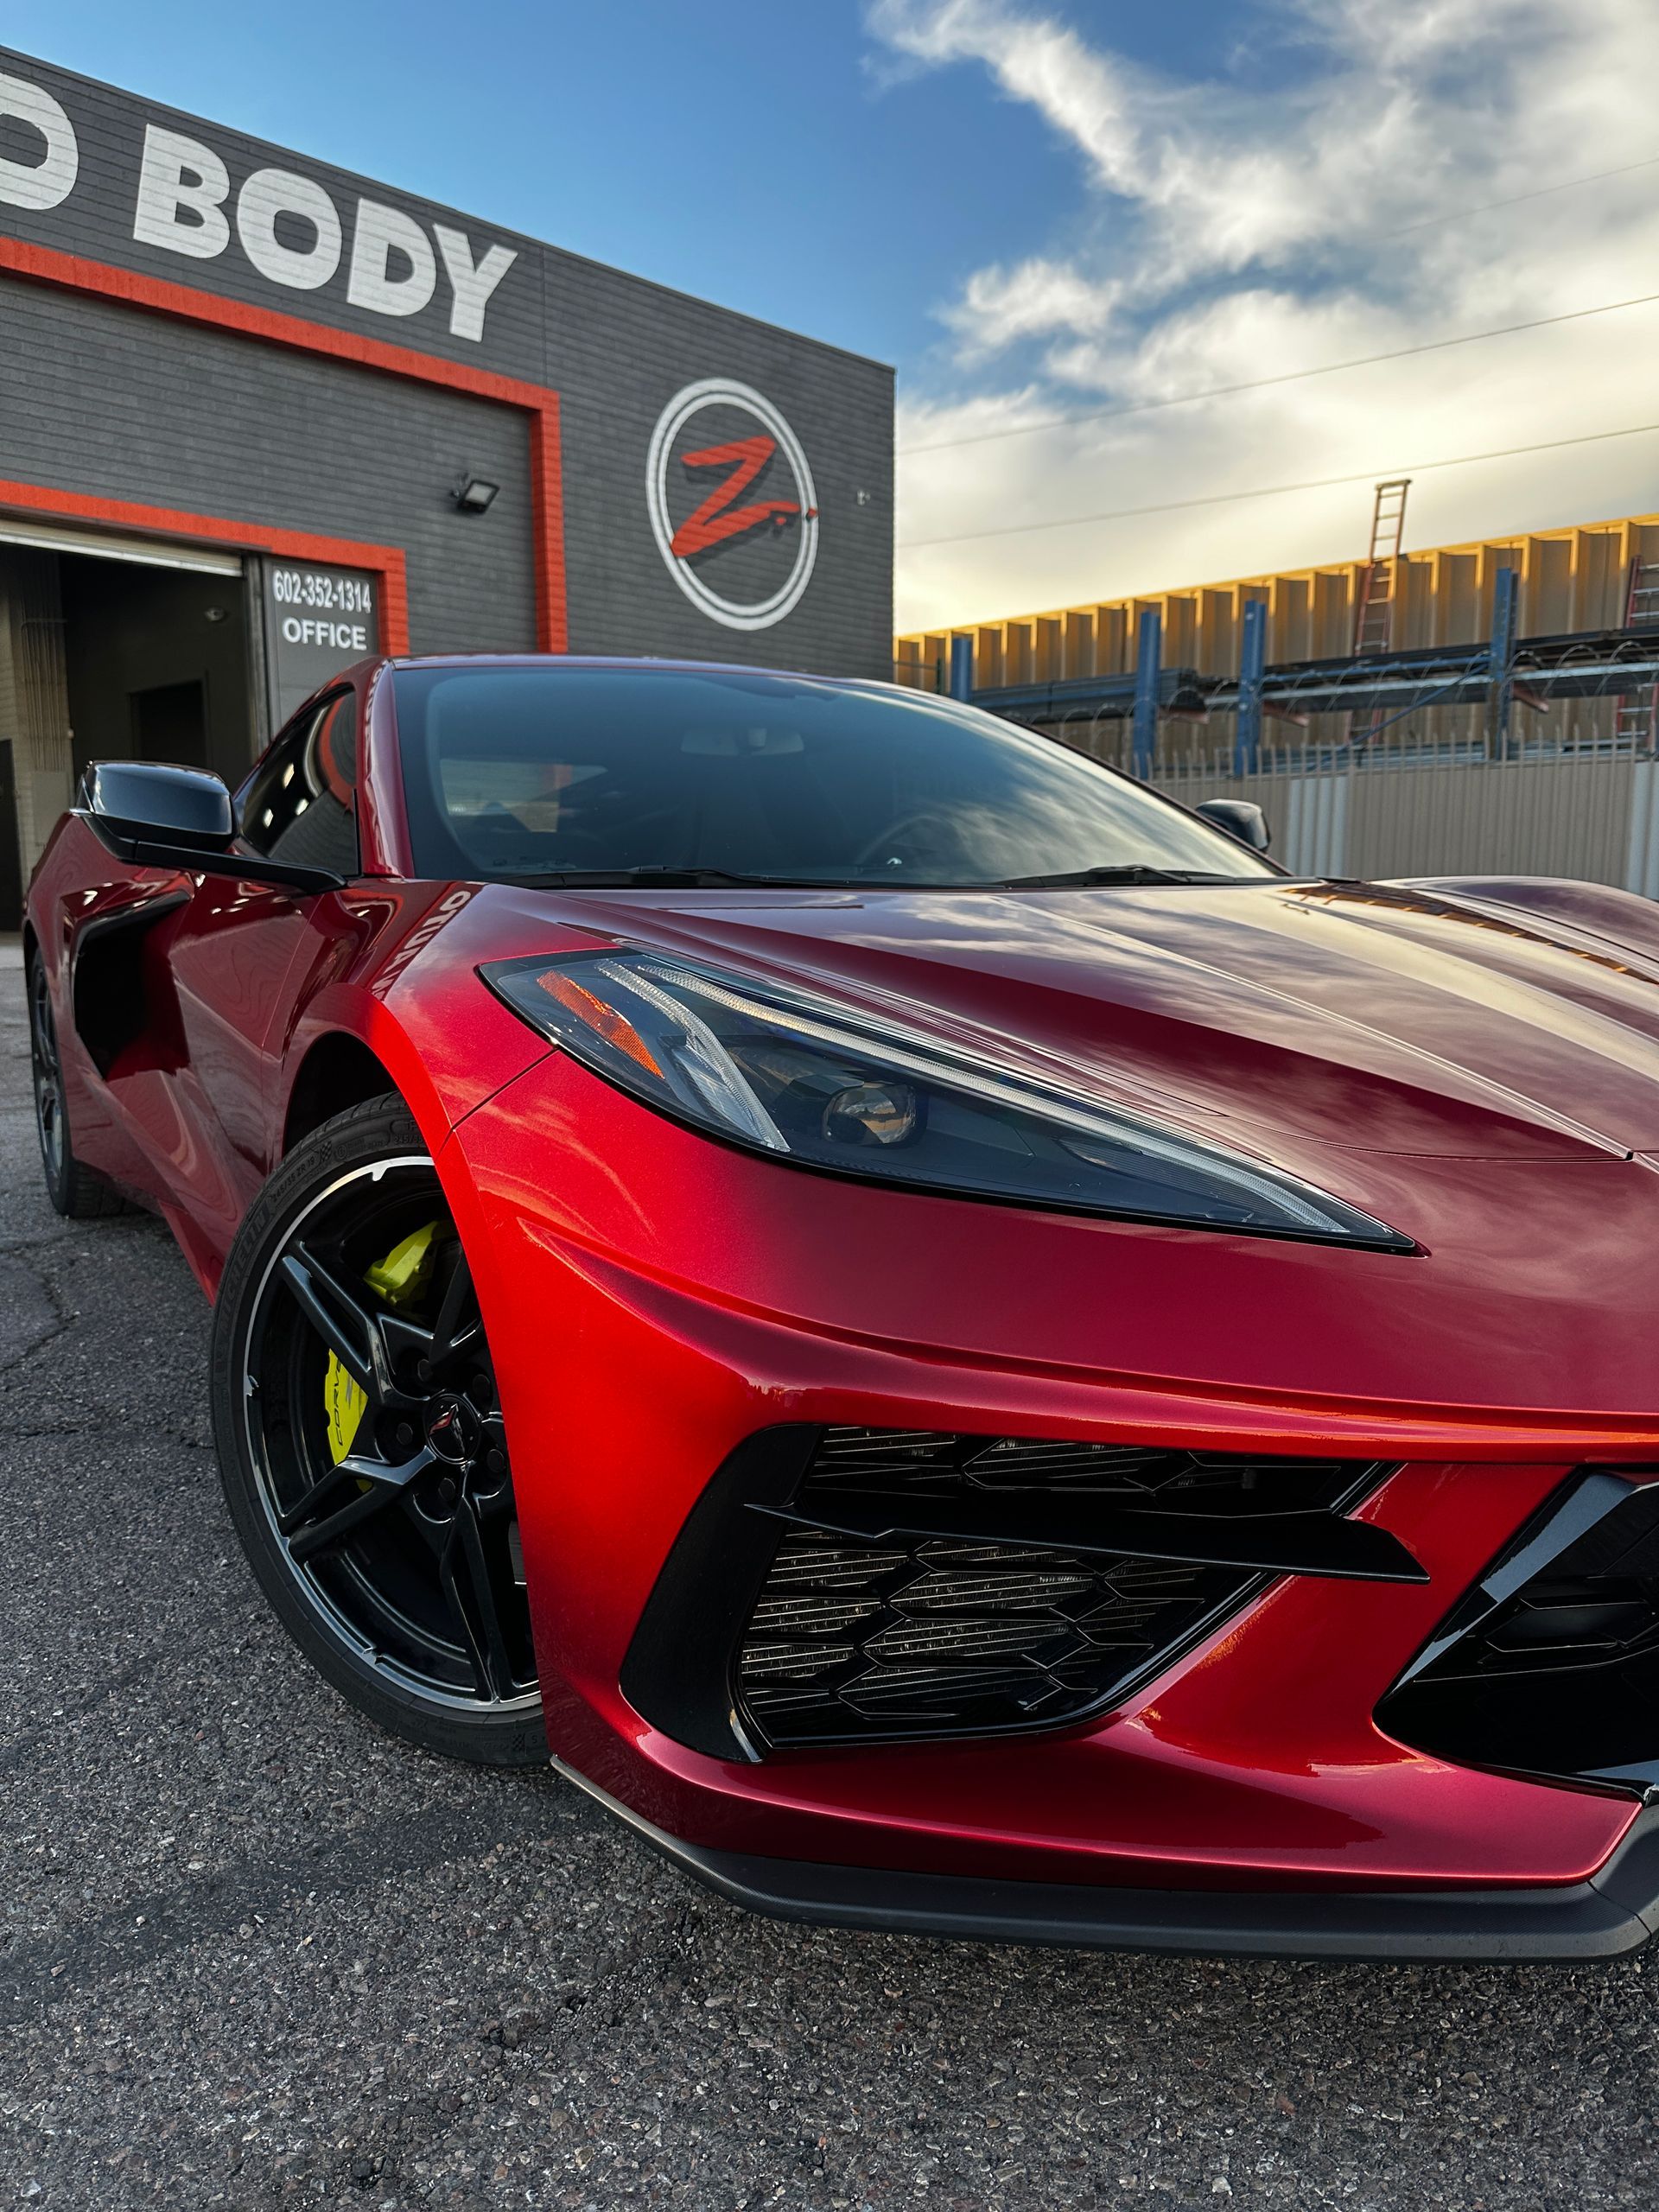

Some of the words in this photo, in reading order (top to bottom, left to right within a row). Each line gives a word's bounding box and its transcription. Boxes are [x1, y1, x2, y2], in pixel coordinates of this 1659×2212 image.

[133, 123, 518, 342] BODY
[273, 569, 372, 613] 602-352-1314
[283, 617, 366, 651] OFFICE
